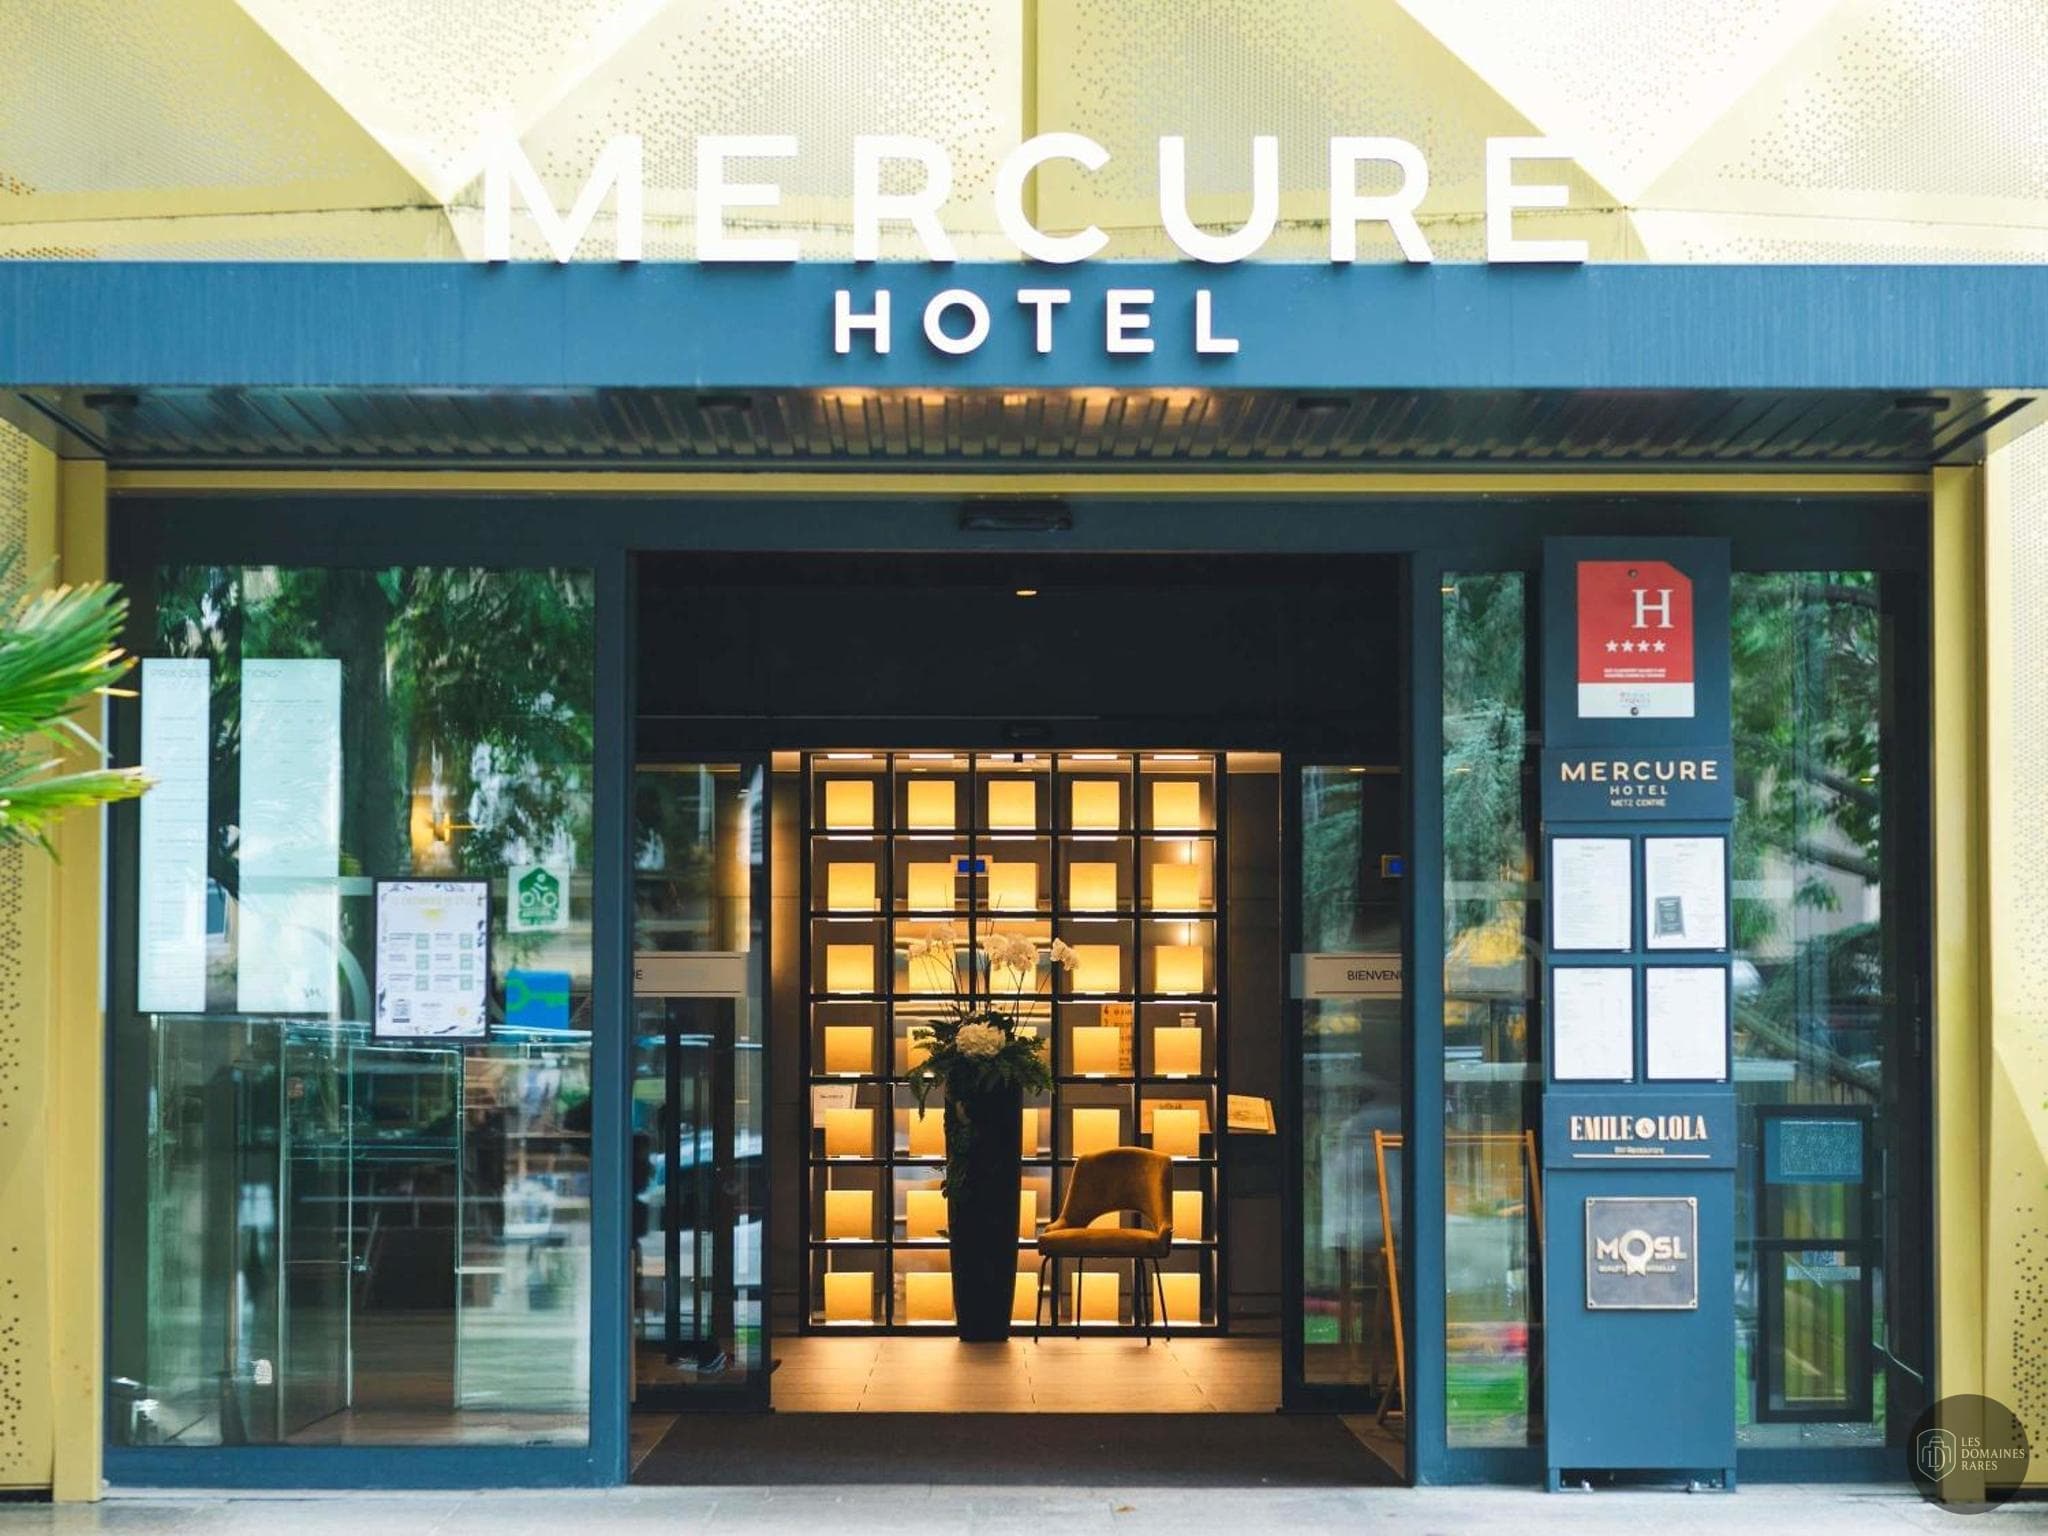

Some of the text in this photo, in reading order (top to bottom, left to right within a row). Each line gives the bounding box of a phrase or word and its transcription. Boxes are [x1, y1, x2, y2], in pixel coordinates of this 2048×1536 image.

[482, 132, 1589, 264] MERCURE
[835, 288, 1239, 354] HOTEL
[1632, 589, 1674, 629] H
[1561, 761, 1718, 782] MERCURE
[1610, 785, 1668, 796] HOTEL
[1611, 798, 1666, 807] METZ CENTRE
[1346, 970, 1401, 981] BIENVEN
[1571, 1115, 1634, 1141] EMILE
[1658, 1115, 1707, 1140] LOLA
